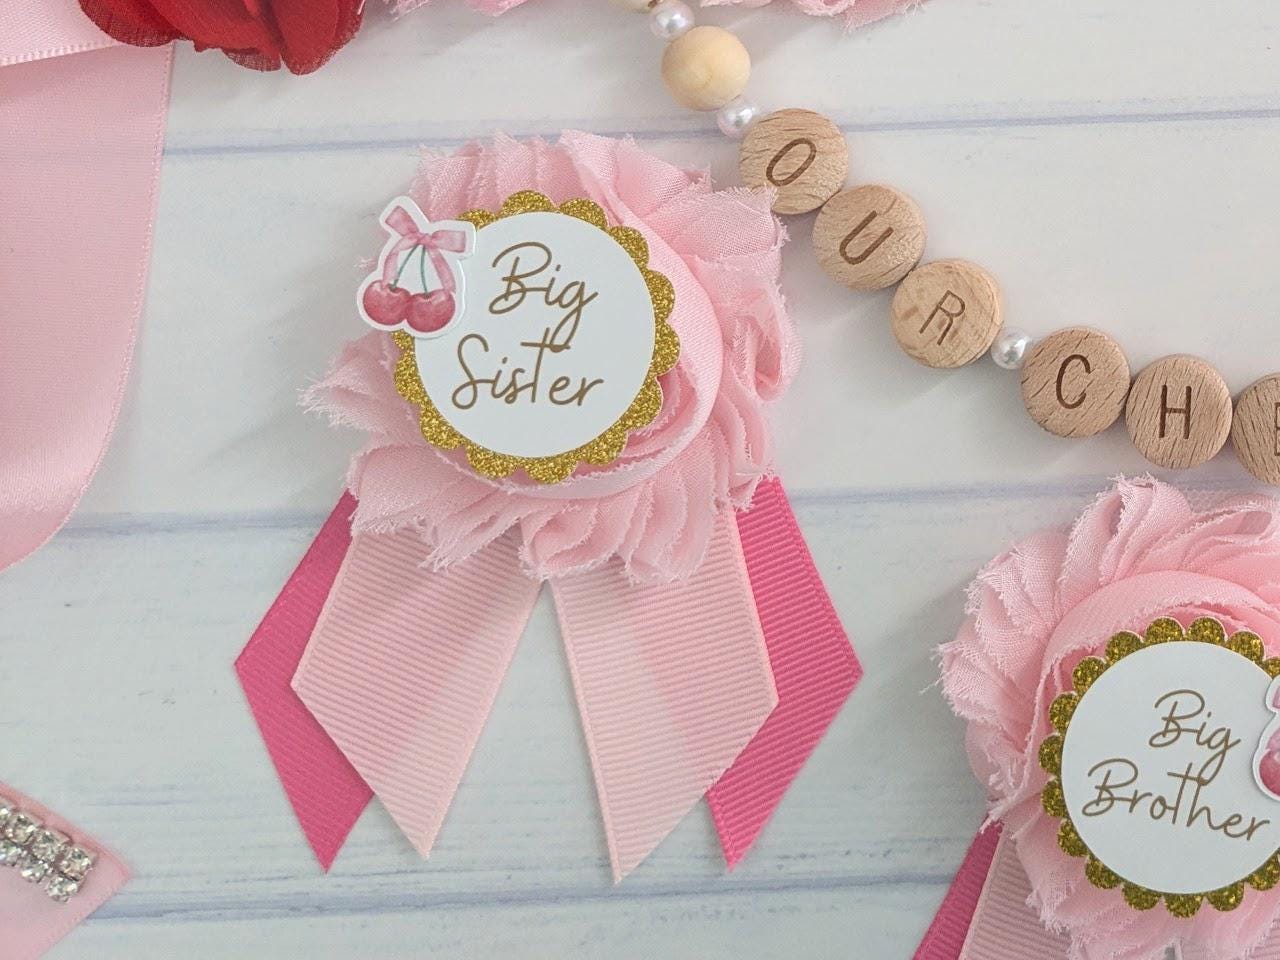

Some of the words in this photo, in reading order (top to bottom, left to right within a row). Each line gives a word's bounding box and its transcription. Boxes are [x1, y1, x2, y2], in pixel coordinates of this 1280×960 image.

[766, 138, 966, 345] OUR
[489, 242, 599, 353] Big
[452, 327, 604, 410] Sister
[1149, 689, 1241, 787] Big
[1082, 758, 1270, 840] Brother
